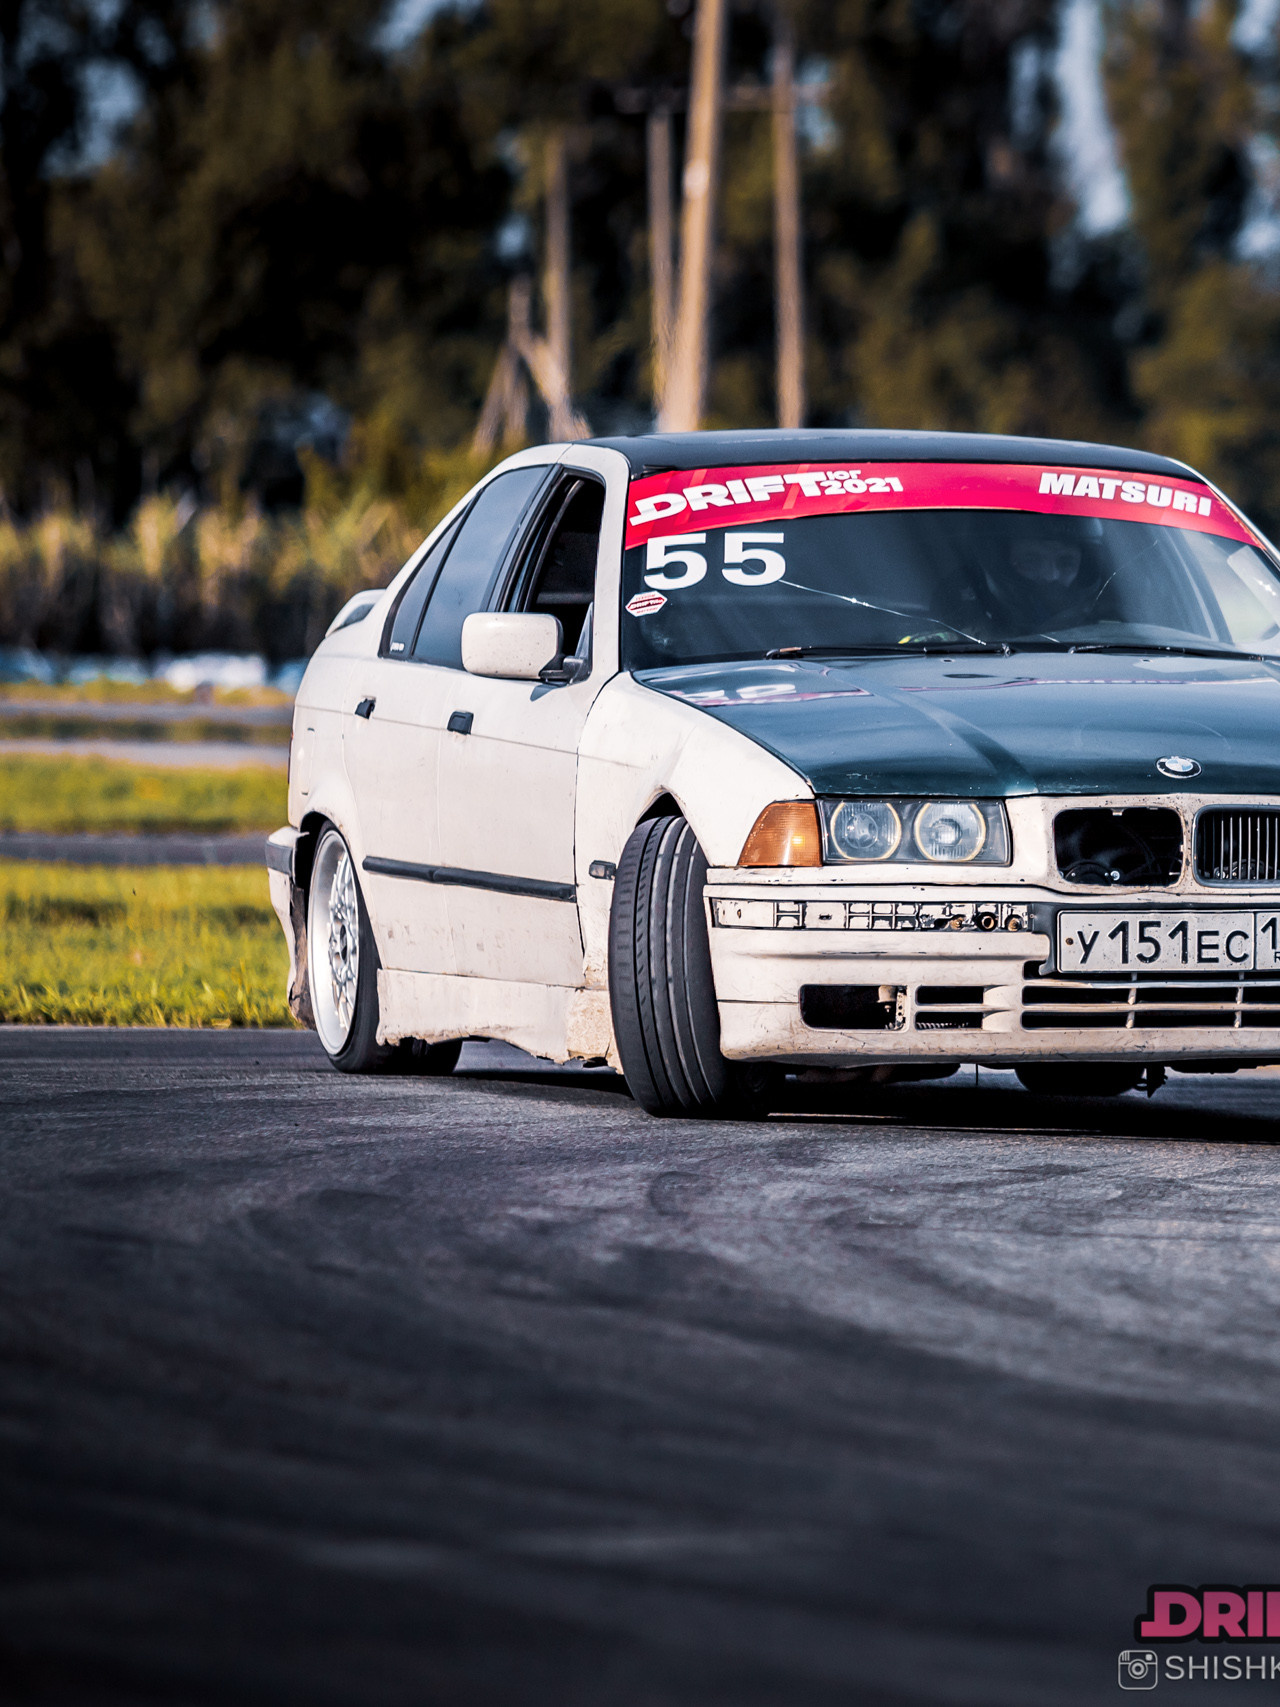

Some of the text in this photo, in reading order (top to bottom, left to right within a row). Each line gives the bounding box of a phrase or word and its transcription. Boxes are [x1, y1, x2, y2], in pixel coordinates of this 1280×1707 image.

[629, 471, 904, 527] DRIFT 2021
[1038, 472, 1212, 517] MATSURI
[643, 531, 787, 591] 55
